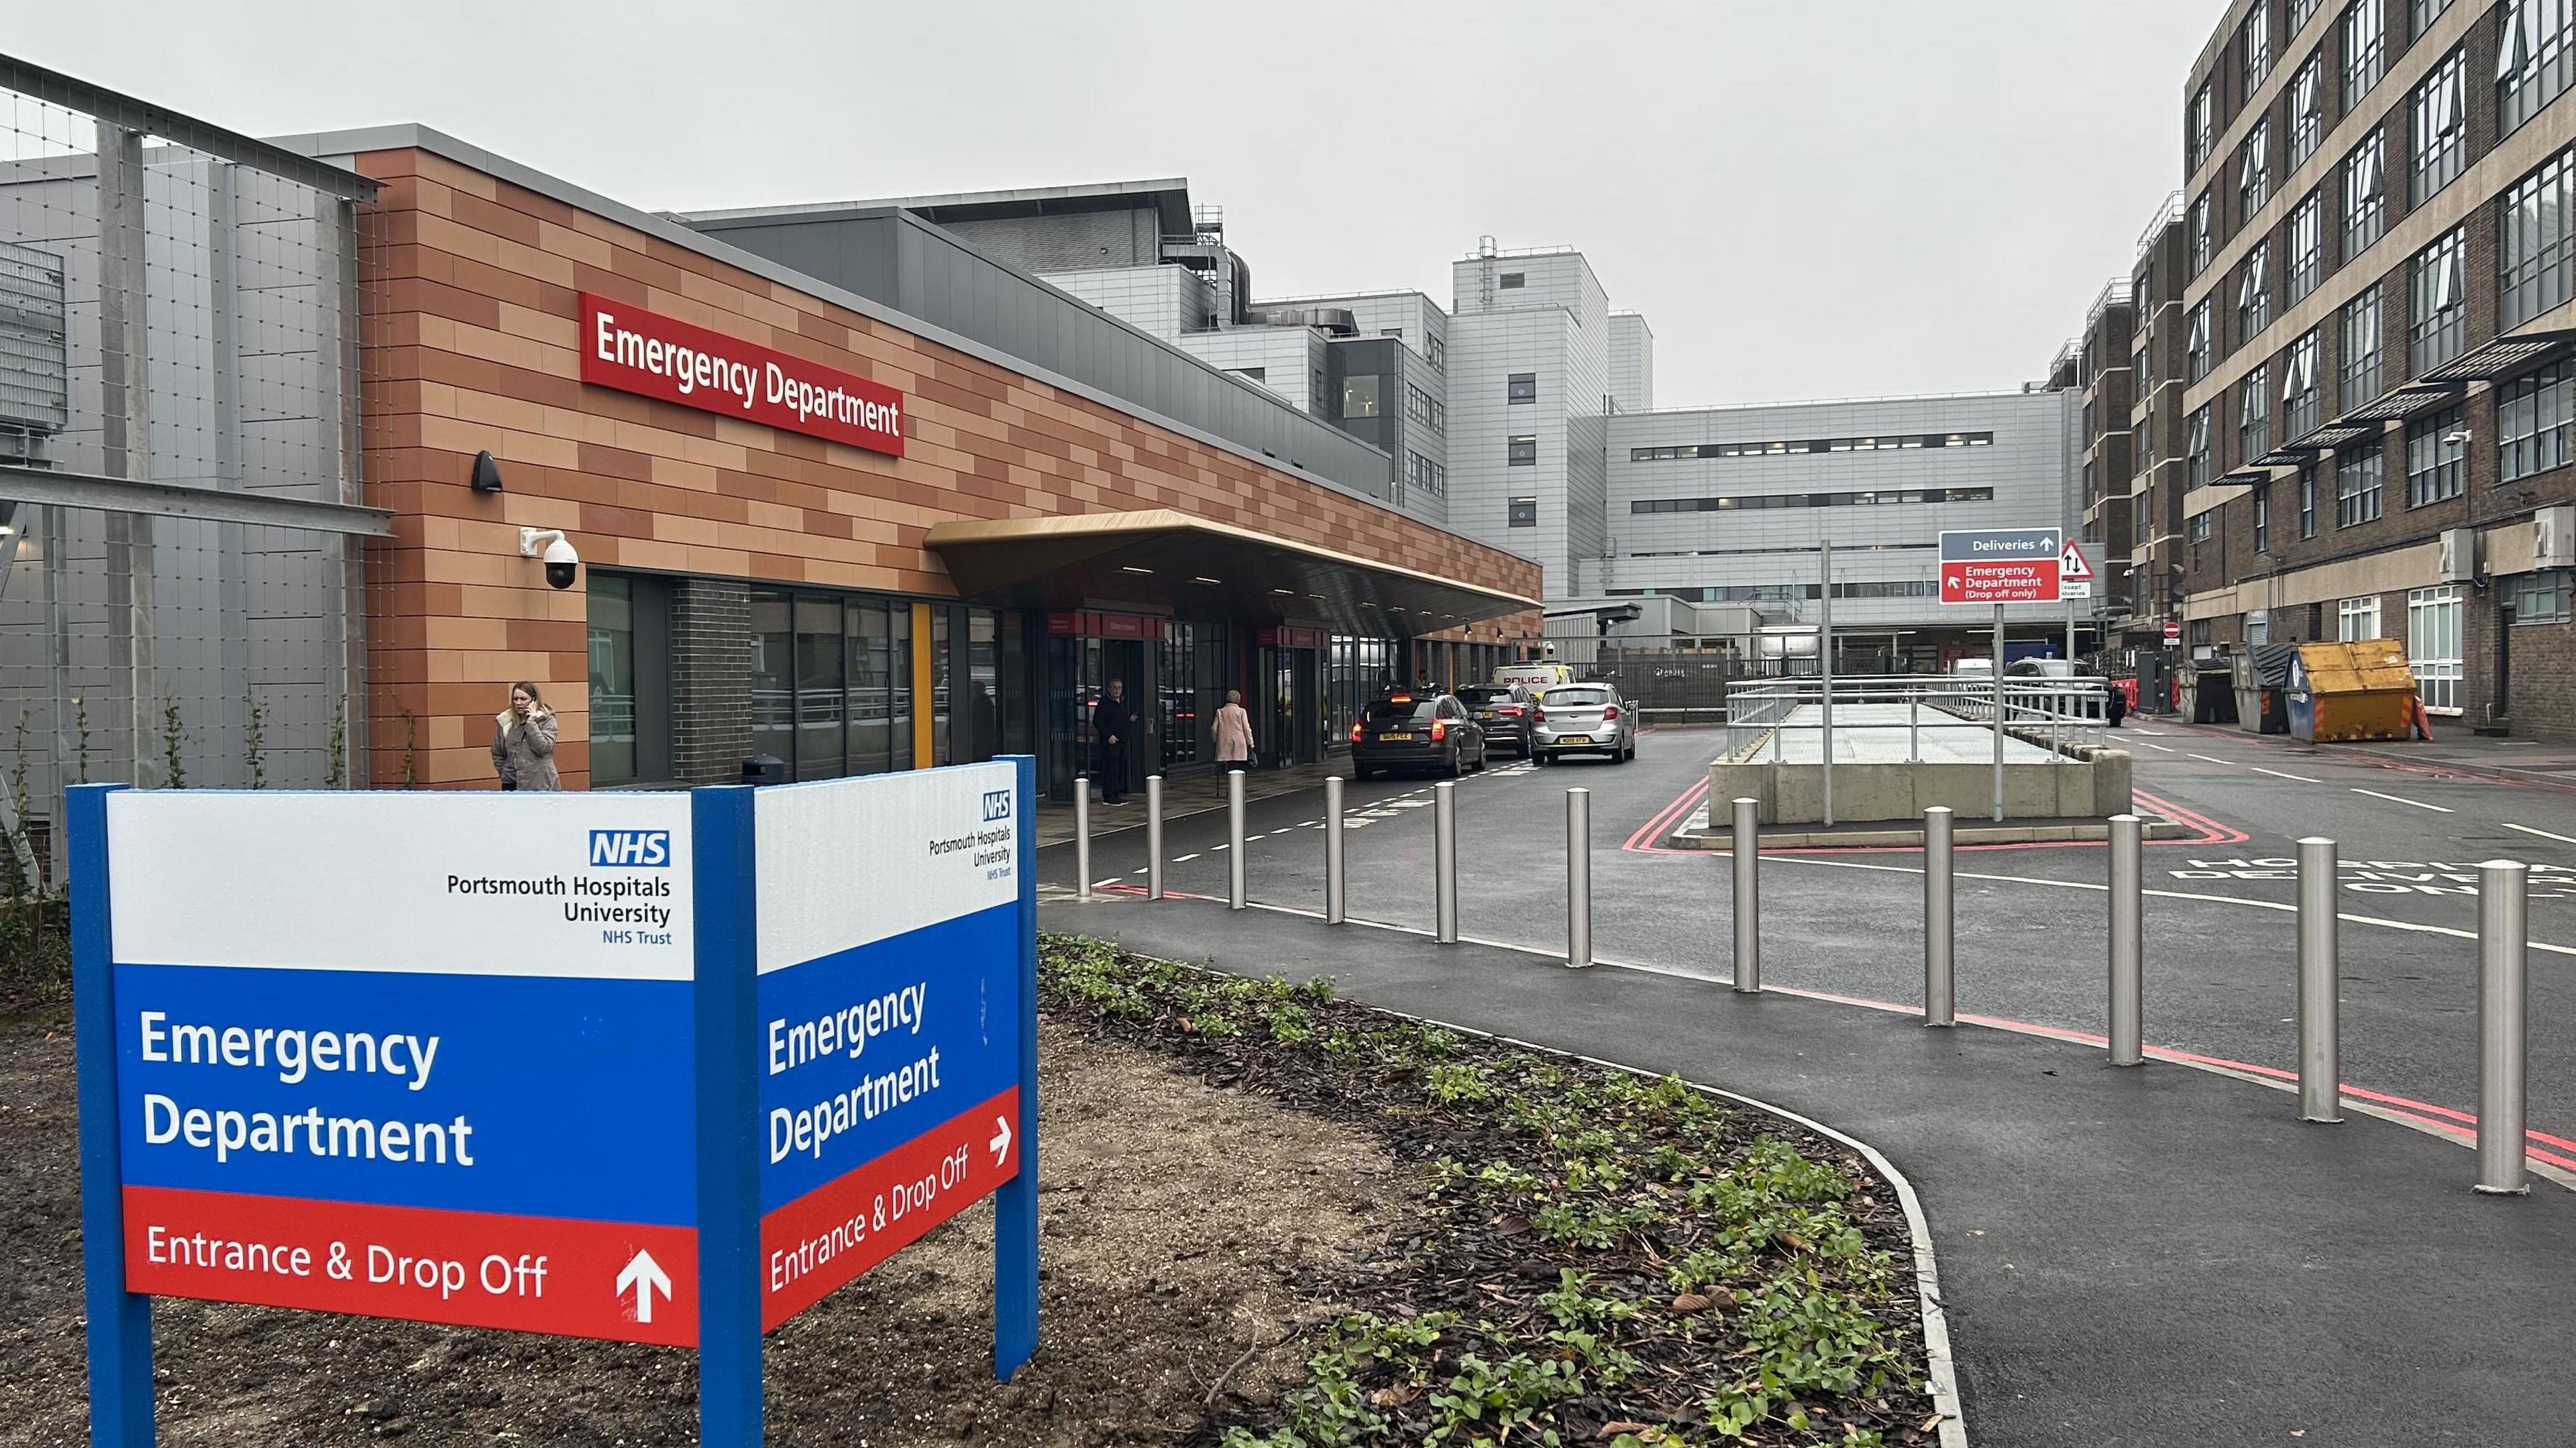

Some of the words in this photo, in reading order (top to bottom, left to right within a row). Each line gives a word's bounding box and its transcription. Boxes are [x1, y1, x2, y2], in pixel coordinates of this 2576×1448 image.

[596, 311, 758, 410] Emergency
[765, 361, 900, 437] Department
[1973, 539, 2035, 551] Deliveries
[1965, 566, 2035, 577] Emergency
[1965, 577, 2042, 588] Department
[1965, 590, 1993, 599] (Drop
[1994, 589, 2010, 598] off
[2012, 588, 2037, 599] only)
[983, 792, 1010, 820] NHS
[591, 832, 667, 865] NHS
[930, 831, 975, 856] Portsmouth
[977, 824, 1010, 847] Hospitals
[973, 845, 1011, 867] University
[447, 875, 566, 895] Portsmouth
[574, 876, 670, 901] Hospitals
[987, 869, 998, 881] NHS
[999, 867, 1011, 878] Trust
[564, 901, 671, 928] University
[602, 930, 633, 944] NHS
[637, 931, 672, 945] Trust
[769, 981, 926, 1076] Emergency
[140, 1010, 440, 1091] Emergency
[769, 1044, 940, 1164] Department
[143, 1093, 474, 1167] Department
[770, 1212, 865, 1293] Entrance
[872, 1193, 887, 1233] &
[892, 1172, 936, 1222] Drop
[941, 1143, 969, 1191] Off
[147, 1225, 311, 1276] Entrance
[326, 1240, 354, 1281] &
[367, 1243, 466, 1300] Drop
[479, 1254, 549, 1298] Off
